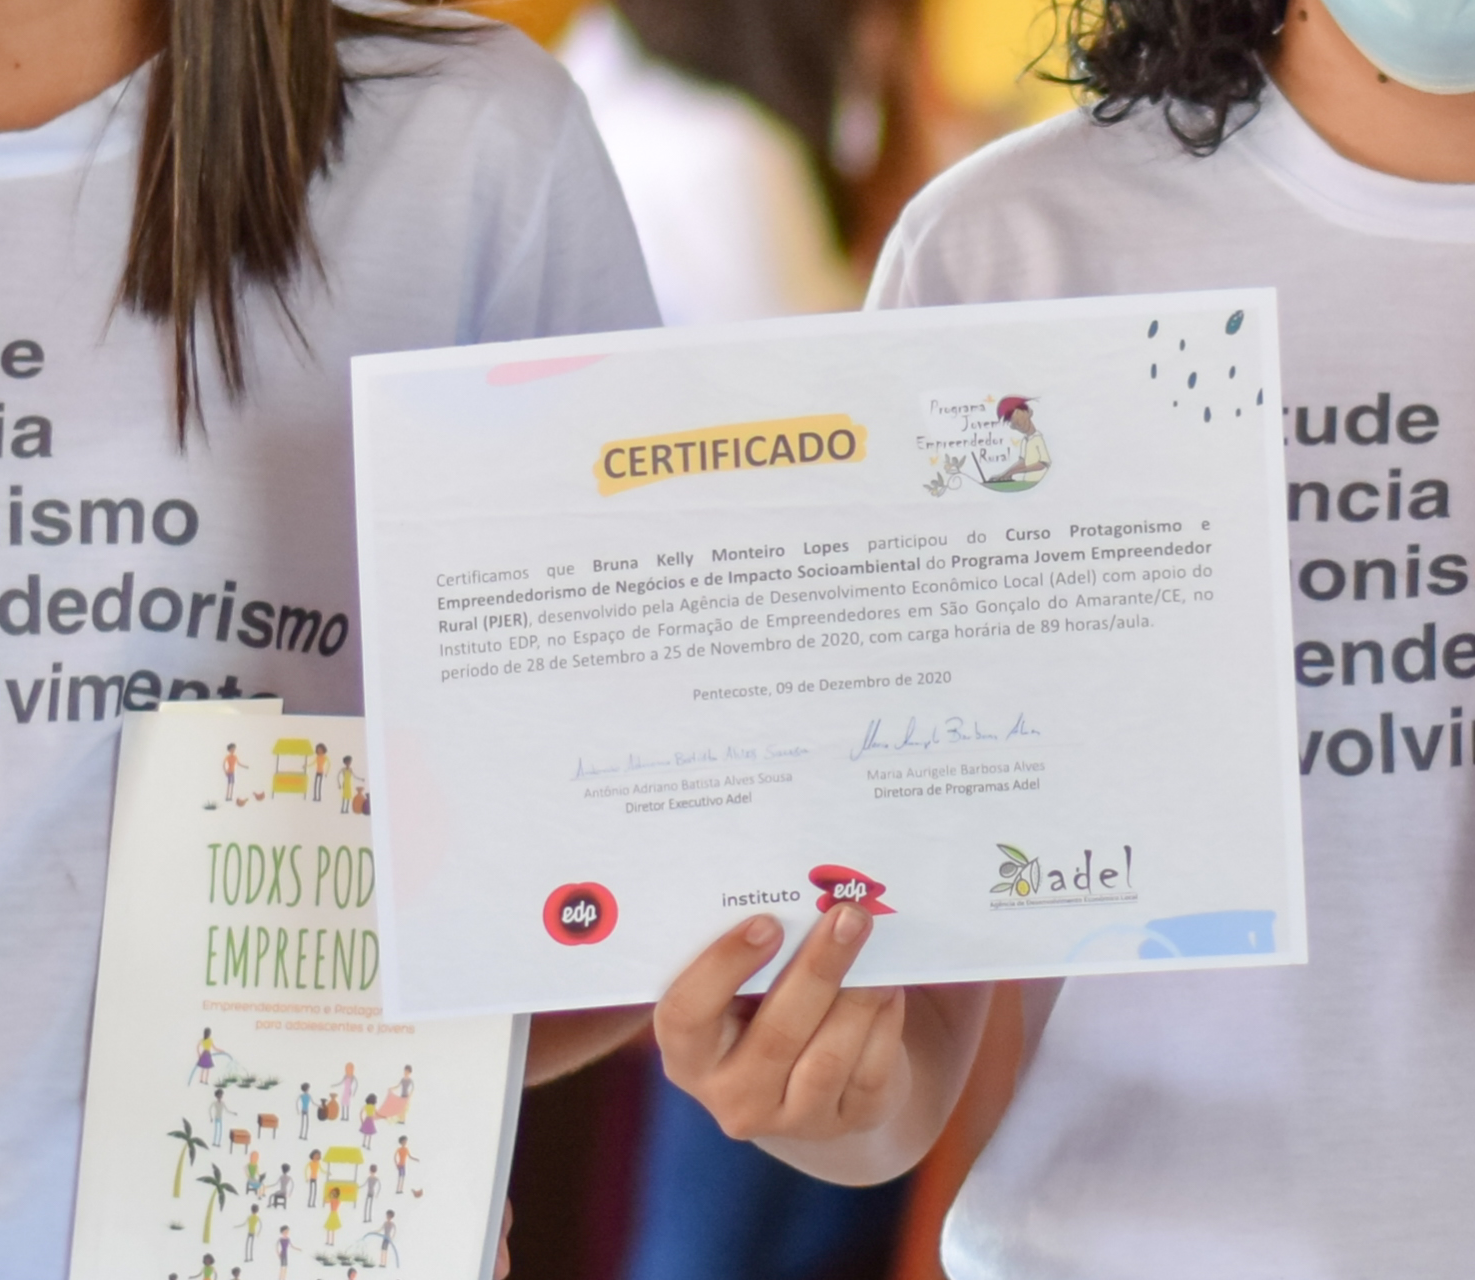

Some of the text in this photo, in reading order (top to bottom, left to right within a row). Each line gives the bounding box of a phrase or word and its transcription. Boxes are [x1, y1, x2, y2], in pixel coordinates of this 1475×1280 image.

[602, 428, 857, 480] CERTIFICADO
[436, 519, 1211, 588] Certificamos que Bruna Kelly Monteiro Lopes participou do Curso Protagonismo e
[437, 540, 1213, 612] Empreendedorismo de Negócios e de Impacto Socioambiental do Programa Jovem Empreendedor
[438, 616, 478, 634] Rural
[537, 602, 637, 625] desenvolvido
[642, 599, 675, 618] pela
[679, 594, 740, 614] Agência
[744, 591, 765, 607] de
[770, 583, 907, 605] Desenvolvimento
[911, 576, 998, 595] Econômico
[1003, 572, 1044, 589] Local
[1049, 568, 1097, 589] (Adel)
[1102, 570, 1137, 584] com
[1141, 567, 1187, 583] apoio
[1192, 563, 1213, 578] do
[439, 640, 503, 657] Instituto
[547, 635, 567, 647] no
[573, 629, 626, 646] Espaço
[631, 624, 651, 640] de
[657, 617, 734, 637] Formação
[739, 615, 759, 630] de
[766, 606, 901, 629] Empreendedores
[907, 606, 933, 619] em
[939, 601, 969, 617] São
[975, 596, 1041, 616] Gonçalo
[1047, 594, 1069, 610] do
[1193, 590, 1215, 602] no
[441, 661, 499, 684] período
[503, 659, 522, 675] de
[526, 657, 545, 673] 28
[549, 655, 568, 670] de
[572, 649, 646, 669] Setembro
[650, 650, 659, 661] a
[663, 644, 682, 660] 25
[686, 643, 706, 658] de
[710, 637, 792, 656] Novembro
[796, 634, 816, 649] de
[868, 631, 903, 645] com
[907, 628, 950, 644] carga
[954, 622, 1011, 639] horária
[1015, 620, 1036, 635] de
[1040, 618, 1060, 634] 89
[207, 842, 303, 908] TODXS
[721, 887, 801, 907] instituto
[1047, 844, 1133, 895] adel
